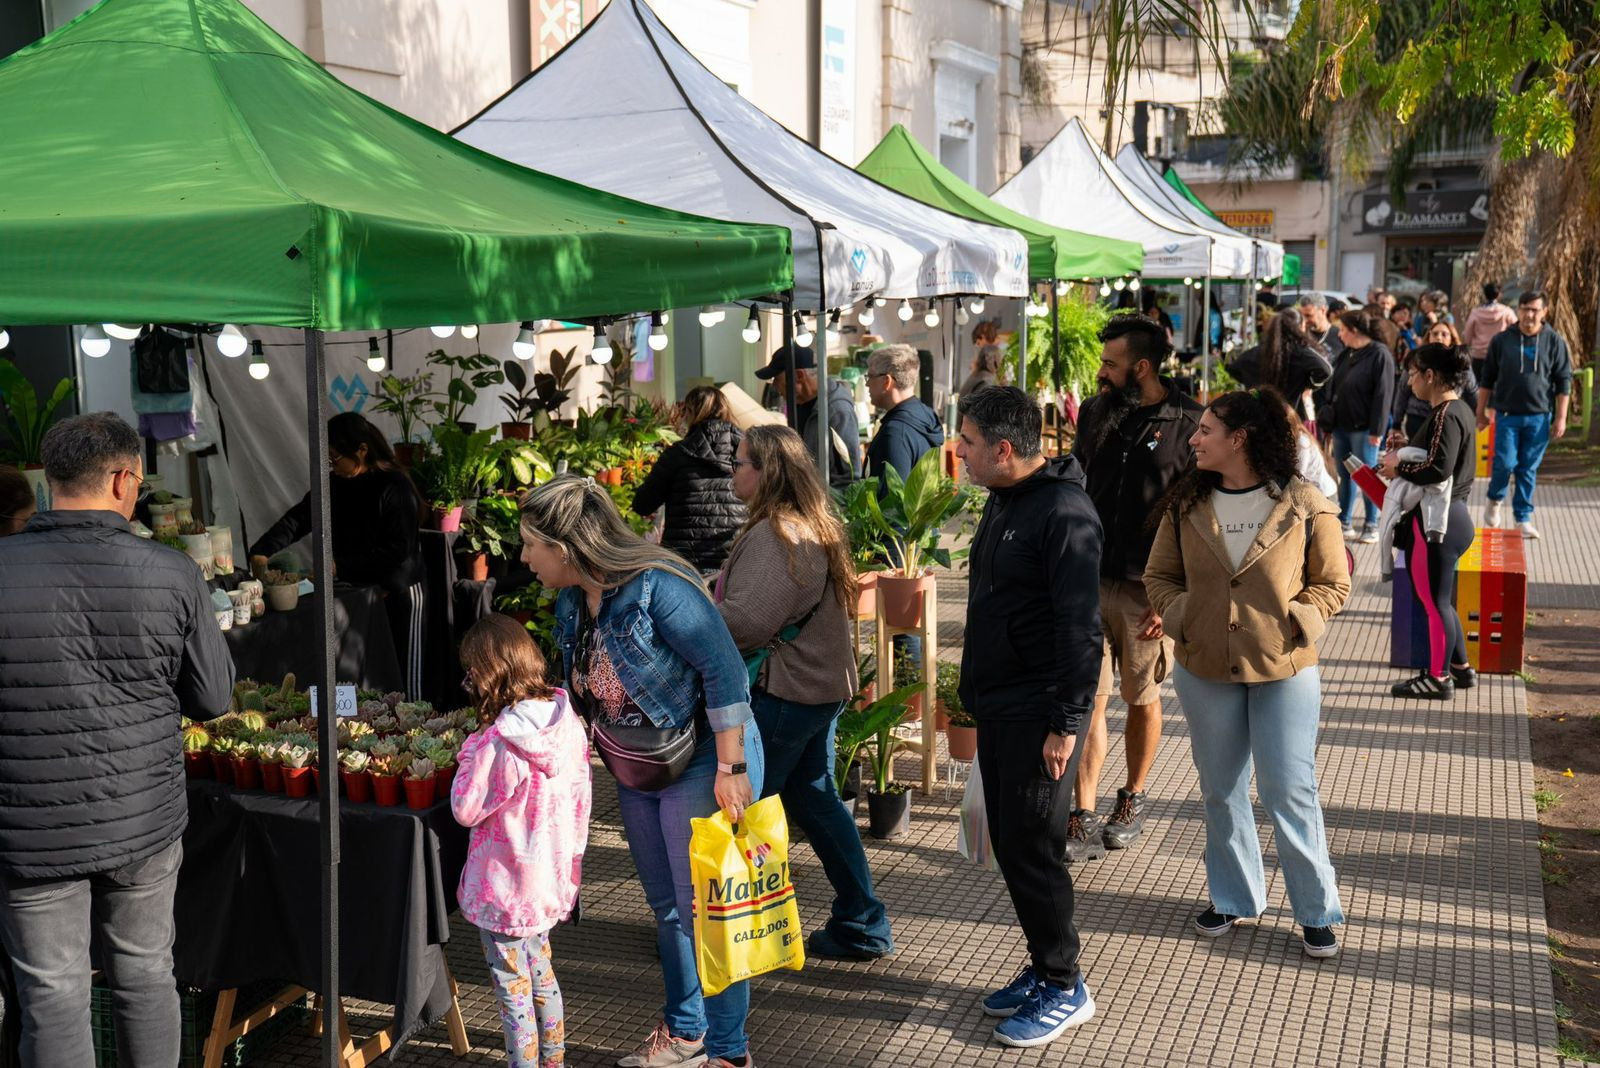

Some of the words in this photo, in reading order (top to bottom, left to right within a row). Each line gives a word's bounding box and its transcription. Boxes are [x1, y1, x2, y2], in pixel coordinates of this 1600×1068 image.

[1393, 211, 1468, 226] DIAMANTE
[707, 861, 787, 904] Mariel
[734, 917, 789, 944] CALZDOS
